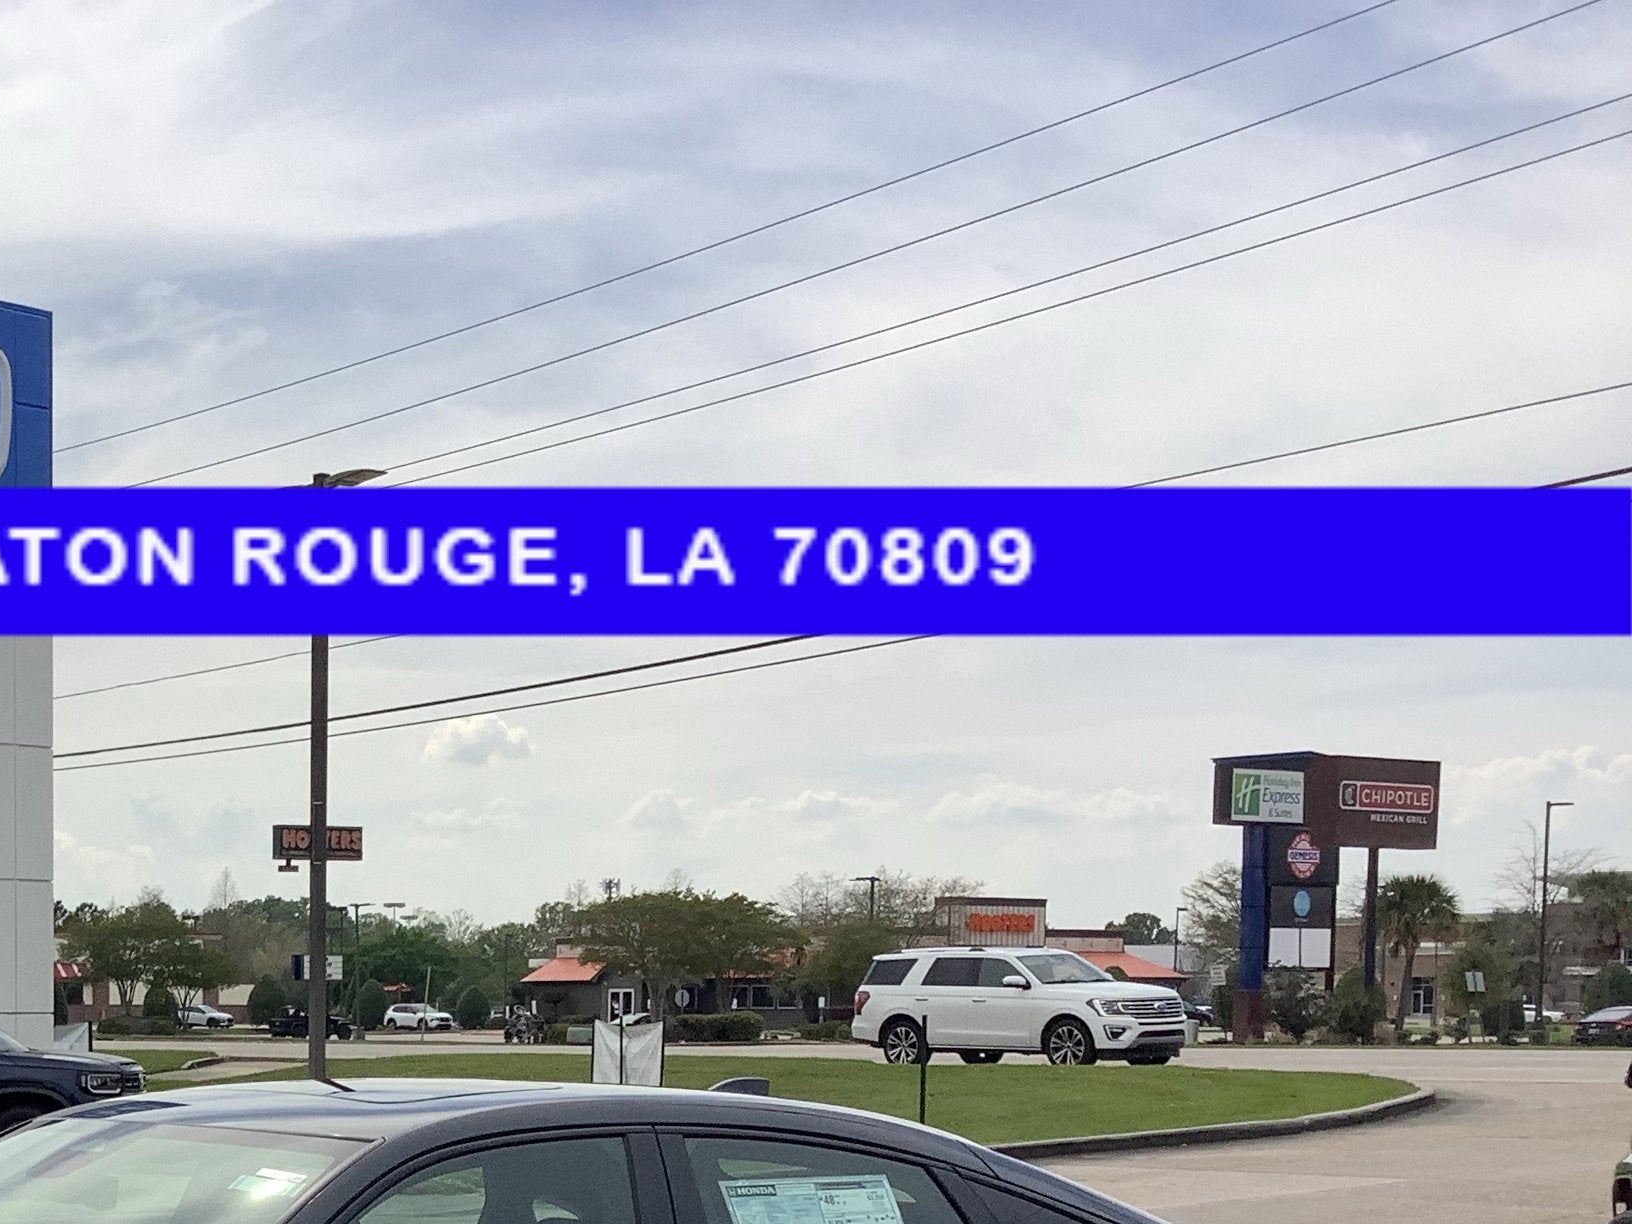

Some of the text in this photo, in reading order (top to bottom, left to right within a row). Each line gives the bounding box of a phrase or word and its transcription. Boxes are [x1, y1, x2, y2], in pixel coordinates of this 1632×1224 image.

[1262, 787, 1300, 806] Express
[1361, 788, 1429, 807] CHIPOTLE
[1370, 813, 1428, 824] MEXICAN GRILL
[282, 828, 362, 850] HOERS
[737, 1186, 775, 1196] HONDA
